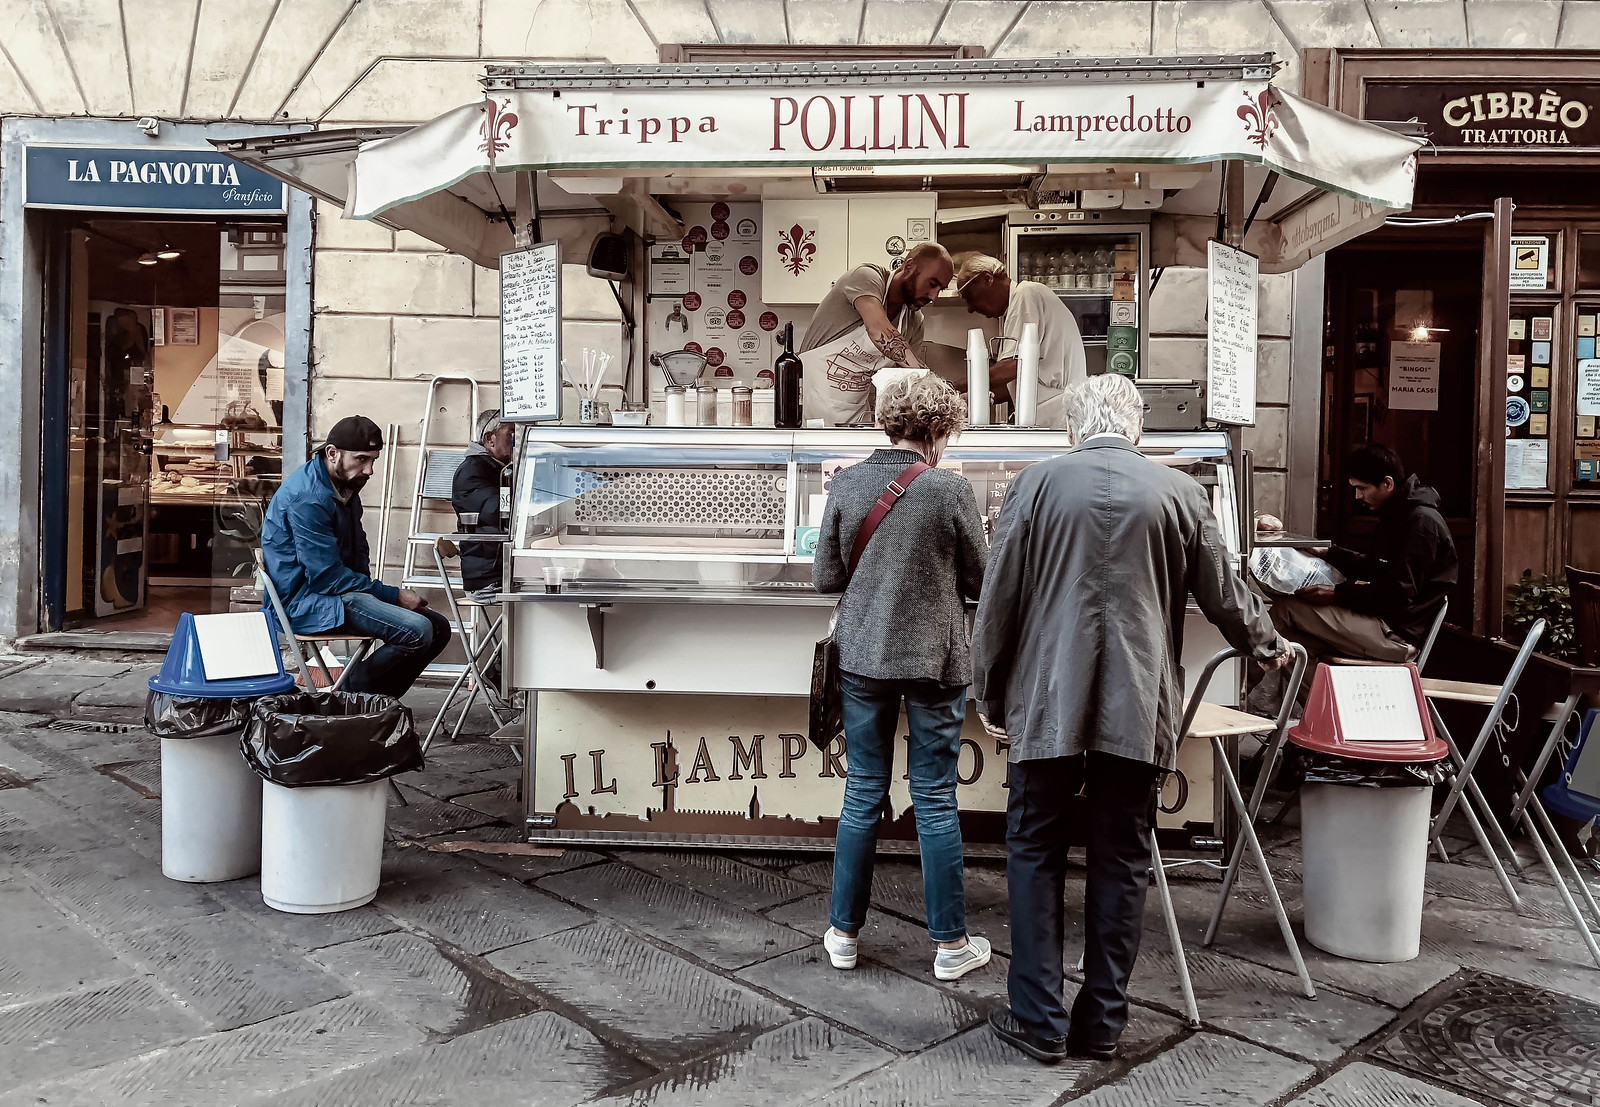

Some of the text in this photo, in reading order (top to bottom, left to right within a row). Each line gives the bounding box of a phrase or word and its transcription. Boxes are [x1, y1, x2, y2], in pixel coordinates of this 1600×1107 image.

[566, 92, 1192, 153] Trippa POLLINI Lampredotto
[1443, 88, 1589, 129] CIBRÈO
[1461, 129, 1570, 144] TRATTORIA
[68, 159, 241, 186] LA PAGNOTTA
[222, 187, 273, 206] Panificio
[560, 749, 618, 798] IL
